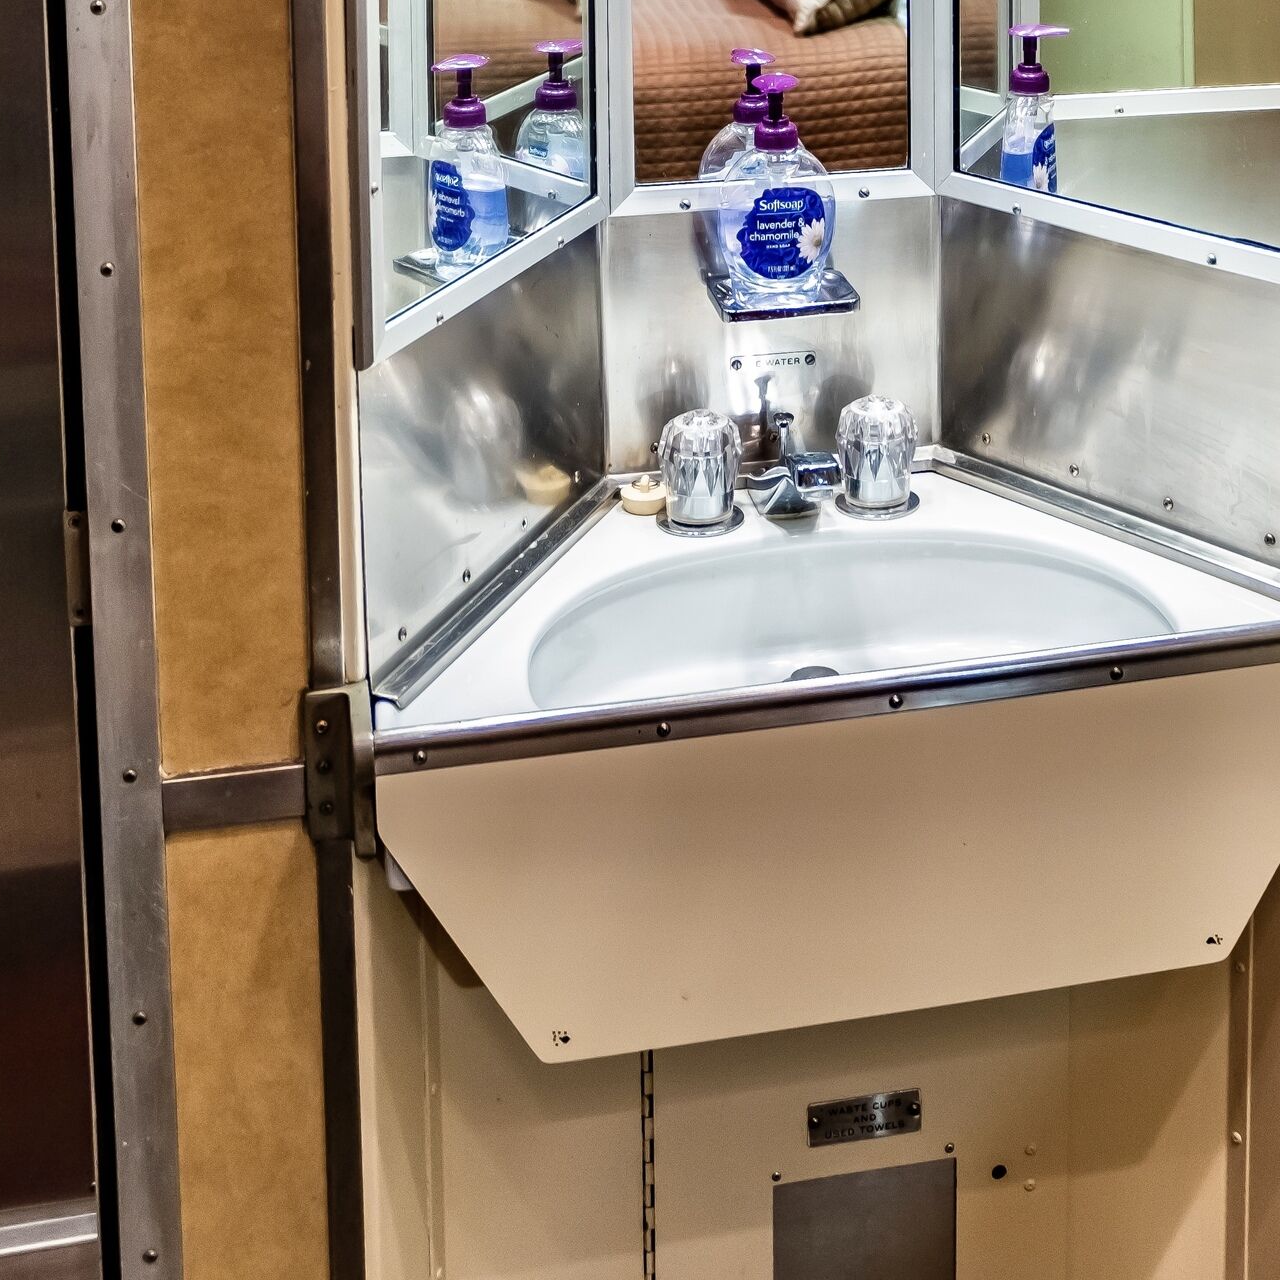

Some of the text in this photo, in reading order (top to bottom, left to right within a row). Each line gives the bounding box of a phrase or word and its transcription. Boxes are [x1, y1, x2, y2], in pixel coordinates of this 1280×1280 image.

[759, 199, 804, 212] Softsoap
[757, 218, 805, 230] lavender &
[749, 230, 800, 241] chamomile
[766, 357, 801, 367] WATER
[828, 1098, 902, 1116] WASTE CUPS
[854, 1113, 877, 1123] AND
[825, 1121, 904, 1139] USED TOWELS
